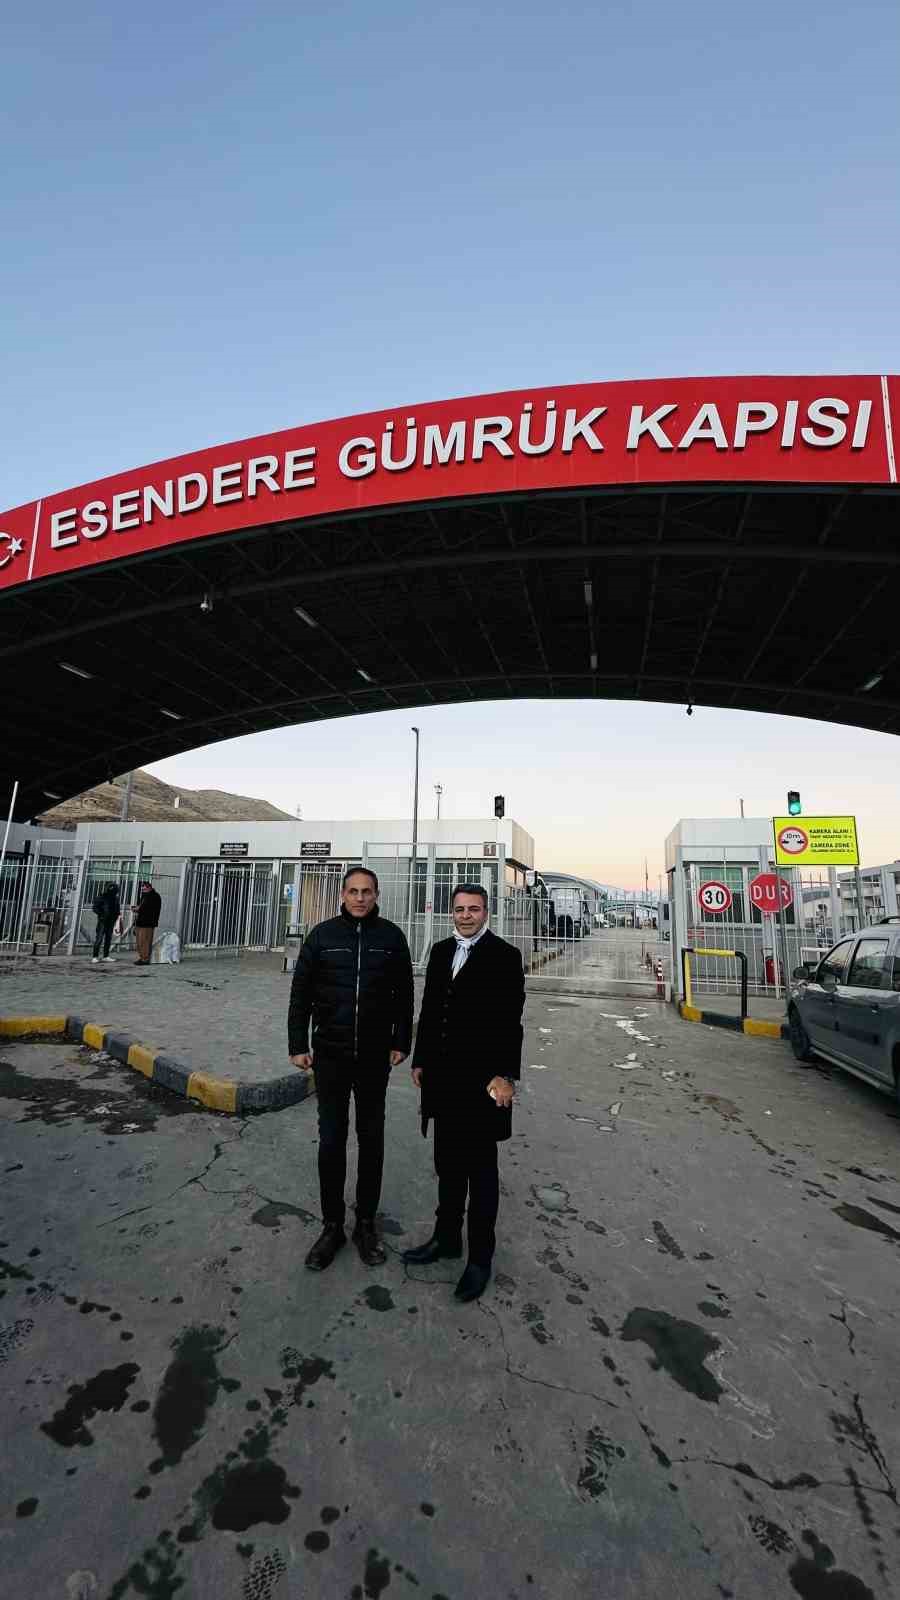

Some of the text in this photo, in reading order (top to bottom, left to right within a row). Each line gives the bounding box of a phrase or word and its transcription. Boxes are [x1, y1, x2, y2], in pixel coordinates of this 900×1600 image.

[50, 397, 873, 548] ESENDERE GÜMRÜK KAPISI
[705, 890, 725, 904] 30
[753, 885, 789, 900] DUR
